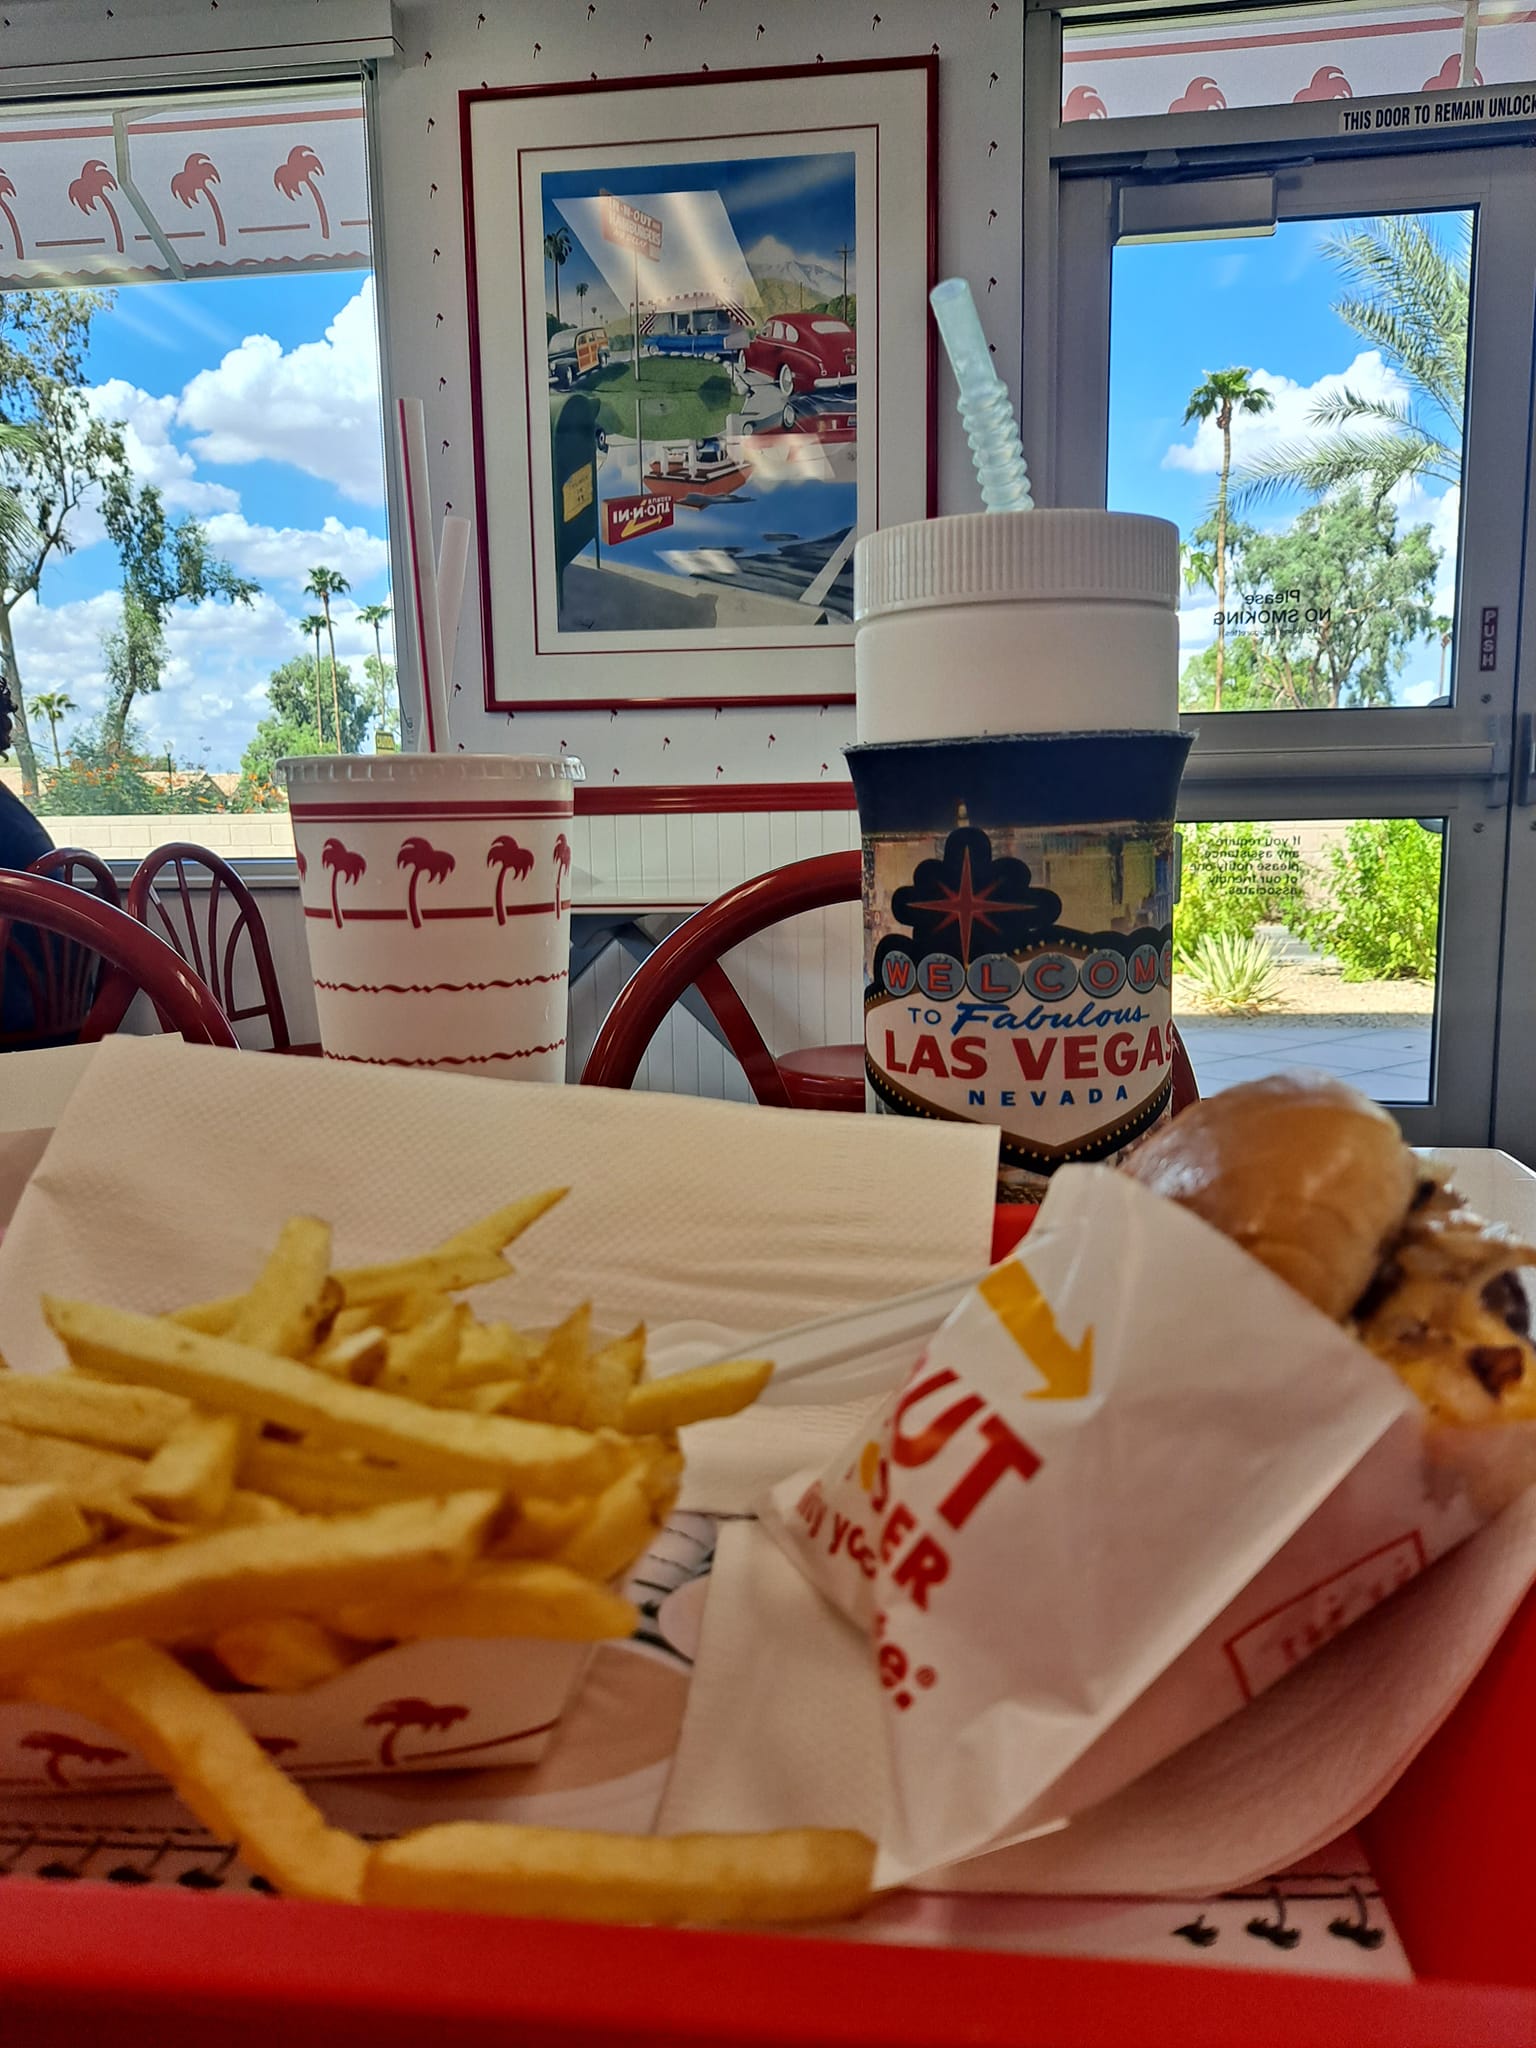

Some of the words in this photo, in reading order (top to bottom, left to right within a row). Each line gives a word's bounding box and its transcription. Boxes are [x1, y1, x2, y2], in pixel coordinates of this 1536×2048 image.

[1343, 110, 1371, 130] THIS
[1376, 106, 1410, 128] DOOR
[1414, 104, 1430, 124] TO
[1434, 99, 1484, 122] REMAIN
[1482, 610, 1497, 667] PUSH
[908, 1007, 941, 1024] TO
[951, 1002, 1149, 1036] Fabulous
[885, 1029, 988, 1080] LAS
[968, 1085, 1128, 1107] NEVADA
